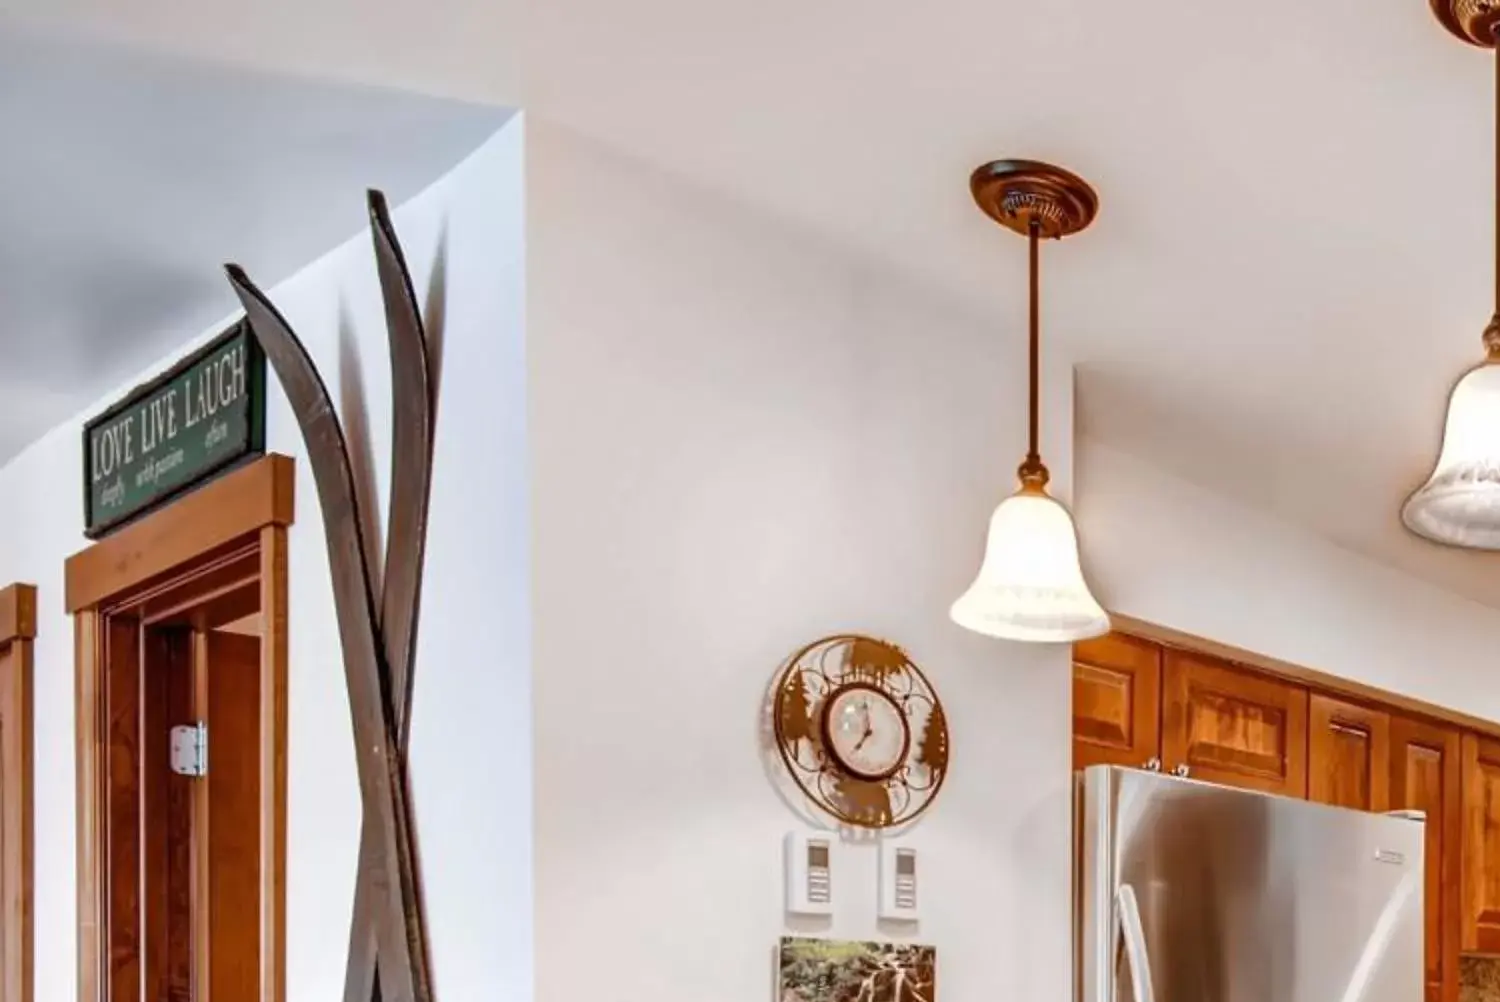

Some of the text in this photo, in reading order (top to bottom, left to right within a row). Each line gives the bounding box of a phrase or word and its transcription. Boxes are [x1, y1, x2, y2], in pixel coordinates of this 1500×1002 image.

[92, 343, 246, 481] LOVE LIVE LAUGH
